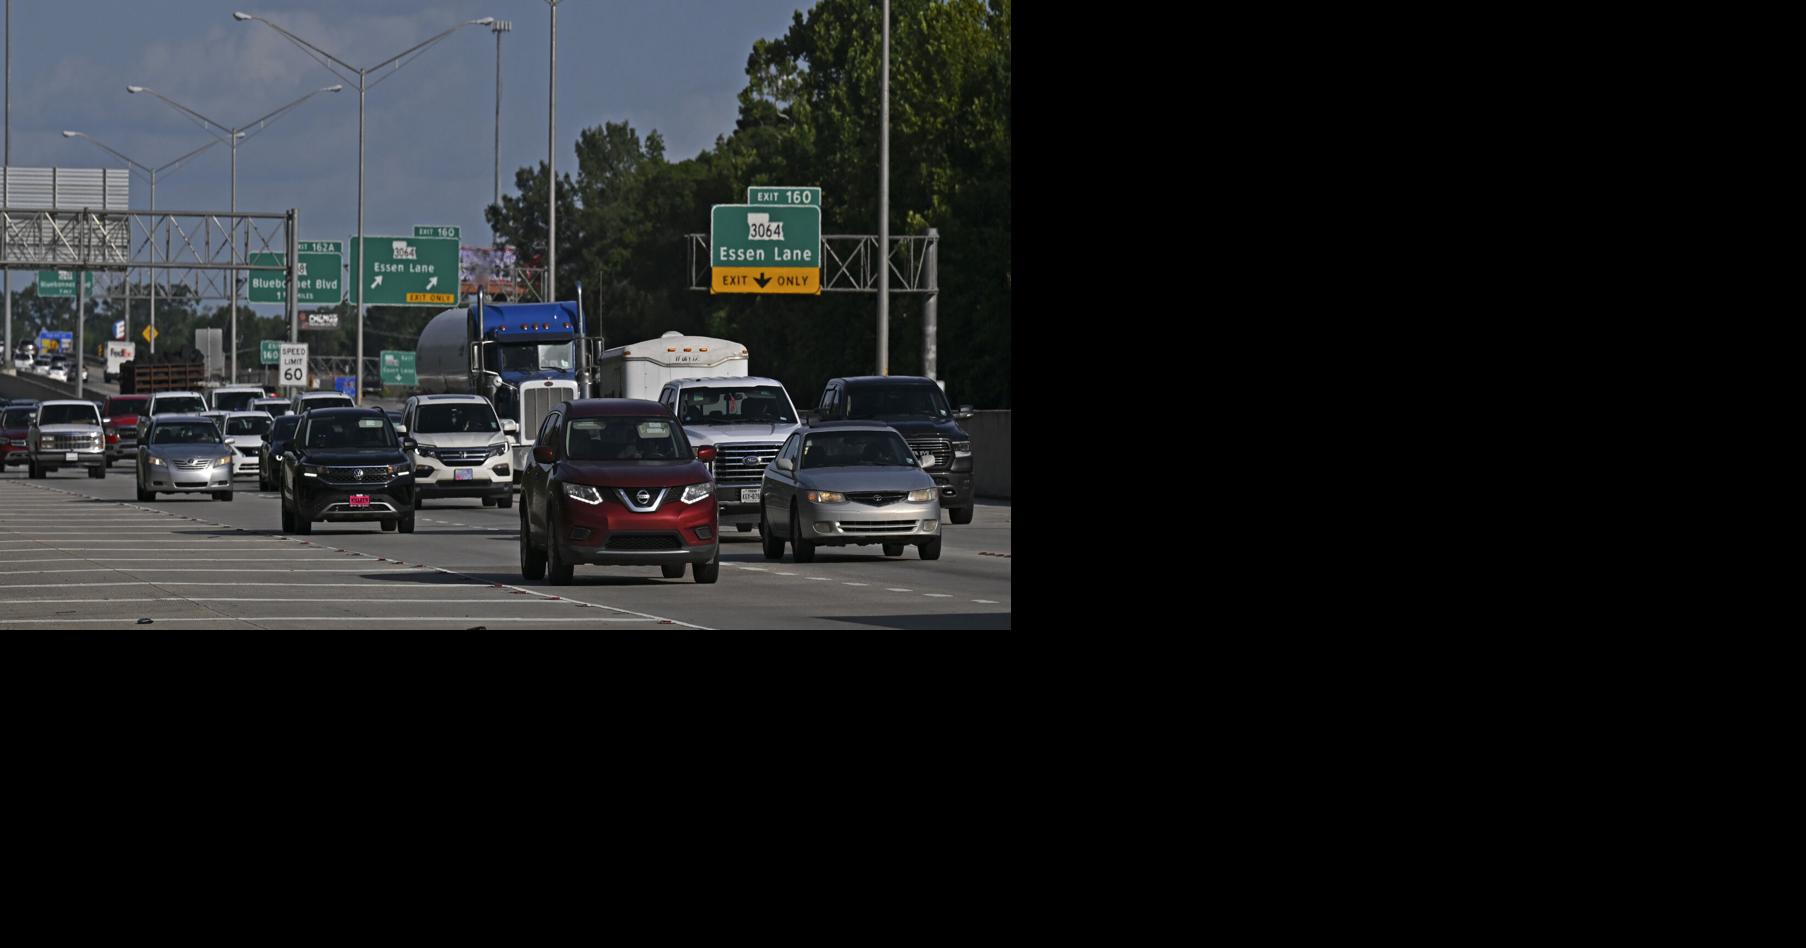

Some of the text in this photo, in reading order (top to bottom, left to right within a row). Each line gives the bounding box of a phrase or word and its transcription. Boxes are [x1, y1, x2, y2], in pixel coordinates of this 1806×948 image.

[757, 191, 812, 204] EXIT 160
[438, 228, 455, 237] 160
[750, 222, 781, 238] 3064
[312, 243, 335, 252] 162A
[394, 247, 415, 257] 3064
[719, 247, 812, 261] Essen Lane
[374, 262, 435, 273] Essen Lane
[315, 279, 338, 289] Blvd
[722, 275, 809, 287] EXIT ONLY
[430, 294, 451, 302] ONLY
[282, 348, 306, 356] SPEED
[284, 358, 303, 366] LIMIT
[284, 367, 303, 381] 60
